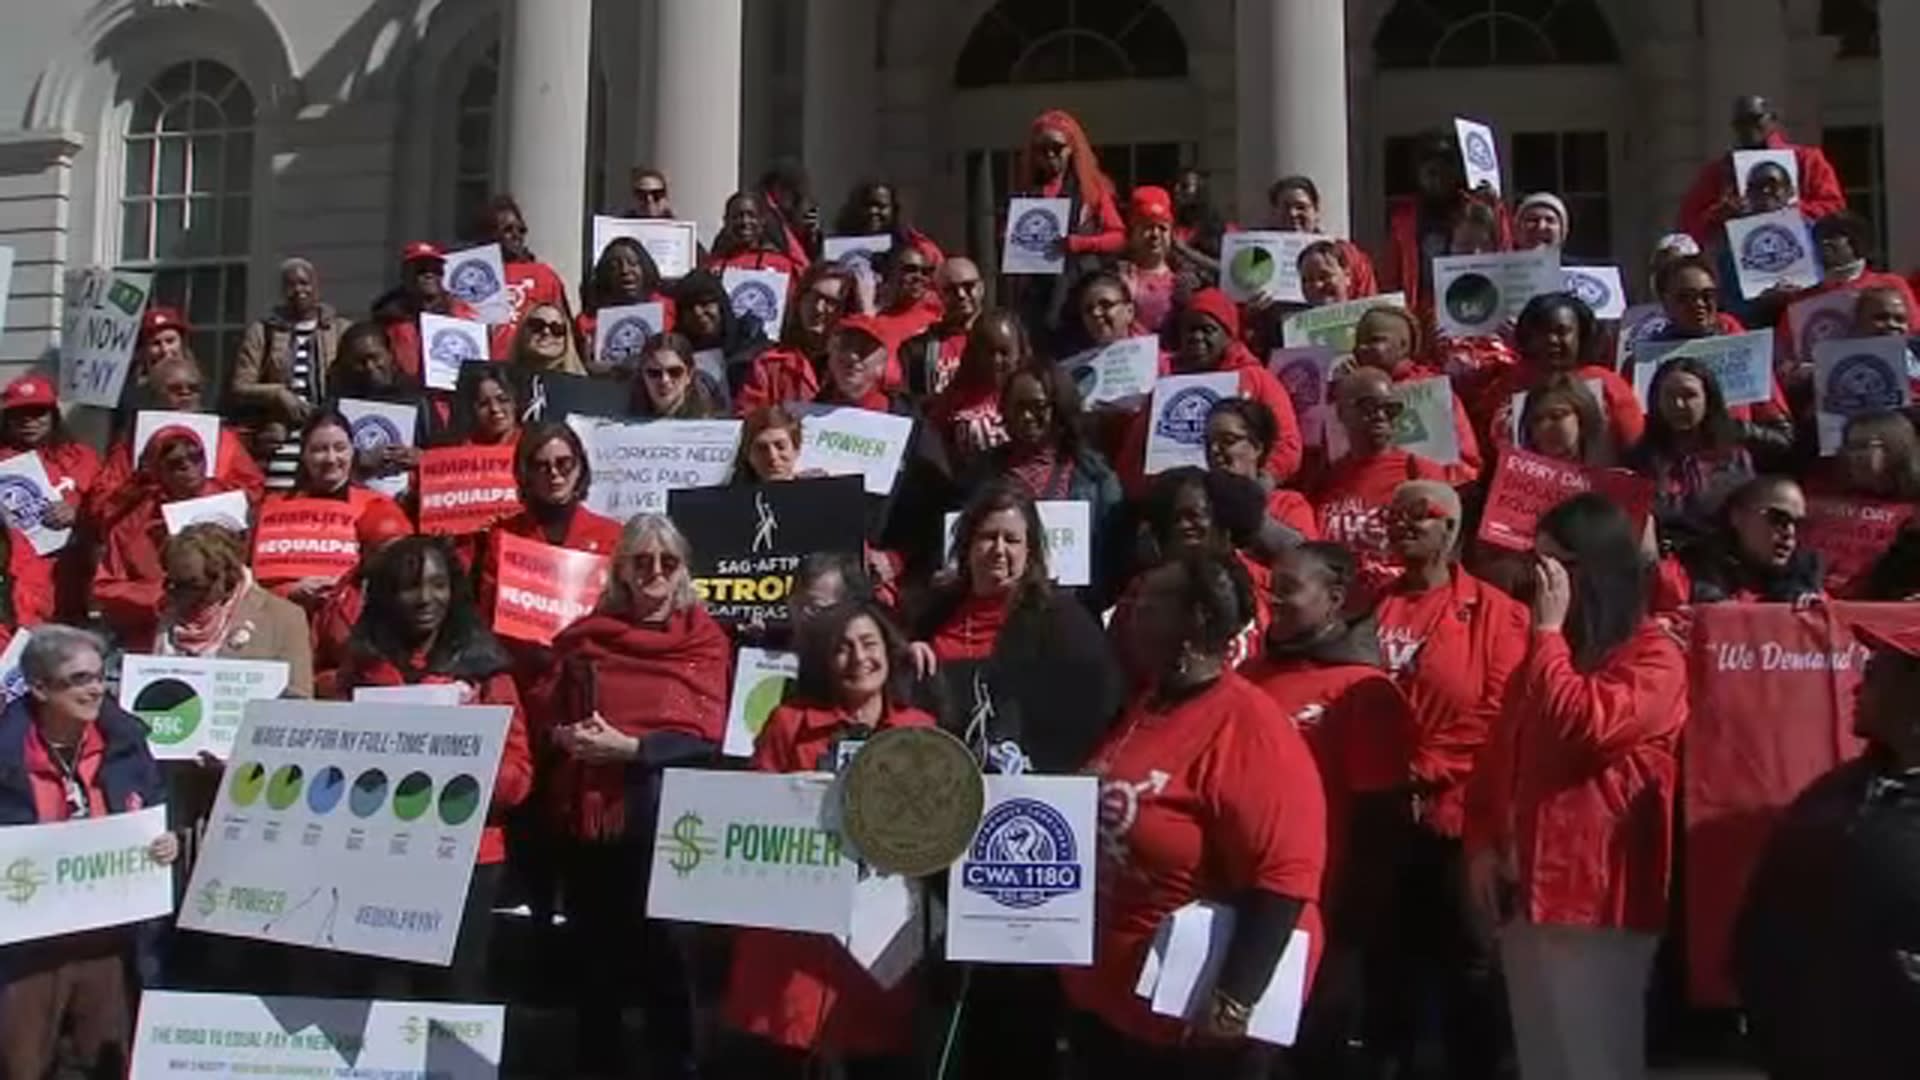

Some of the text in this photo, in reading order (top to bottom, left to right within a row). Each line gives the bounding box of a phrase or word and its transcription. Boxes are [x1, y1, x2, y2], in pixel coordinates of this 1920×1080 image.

[687, 447, 731, 462] NEED
[816, 430, 886, 457] POWHER
[1506, 455, 1556, 481] EVERY
[423, 487, 516, 509] #EQUALPA
[252, 726, 289, 748] WAGE
[288, 727, 313, 749] GAP
[314, 729, 340, 750] FOR
[429, 733, 484, 757] WOMEN
[724, 823, 842, 867] POWHER
[967, 866, 1075, 886] CWA 1180
